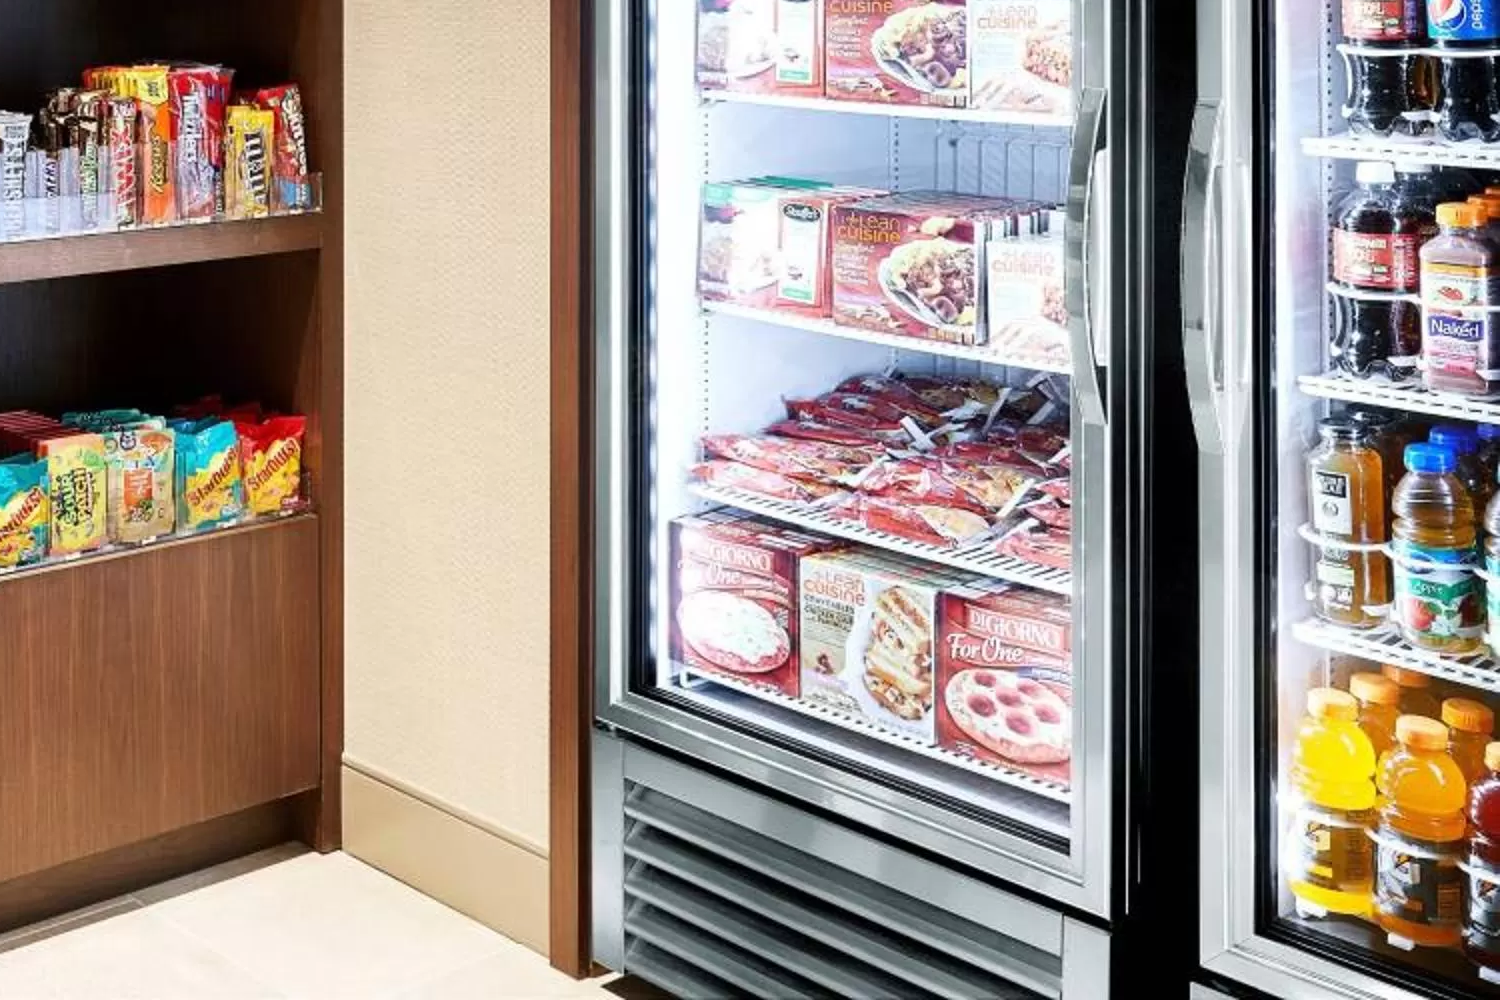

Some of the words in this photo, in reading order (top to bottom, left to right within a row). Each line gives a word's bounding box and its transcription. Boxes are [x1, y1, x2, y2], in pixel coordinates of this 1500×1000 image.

[179, 92, 202, 163] Twizzlers
[948, 633, 981, 660] For
[981, 635, 1024, 662] One
